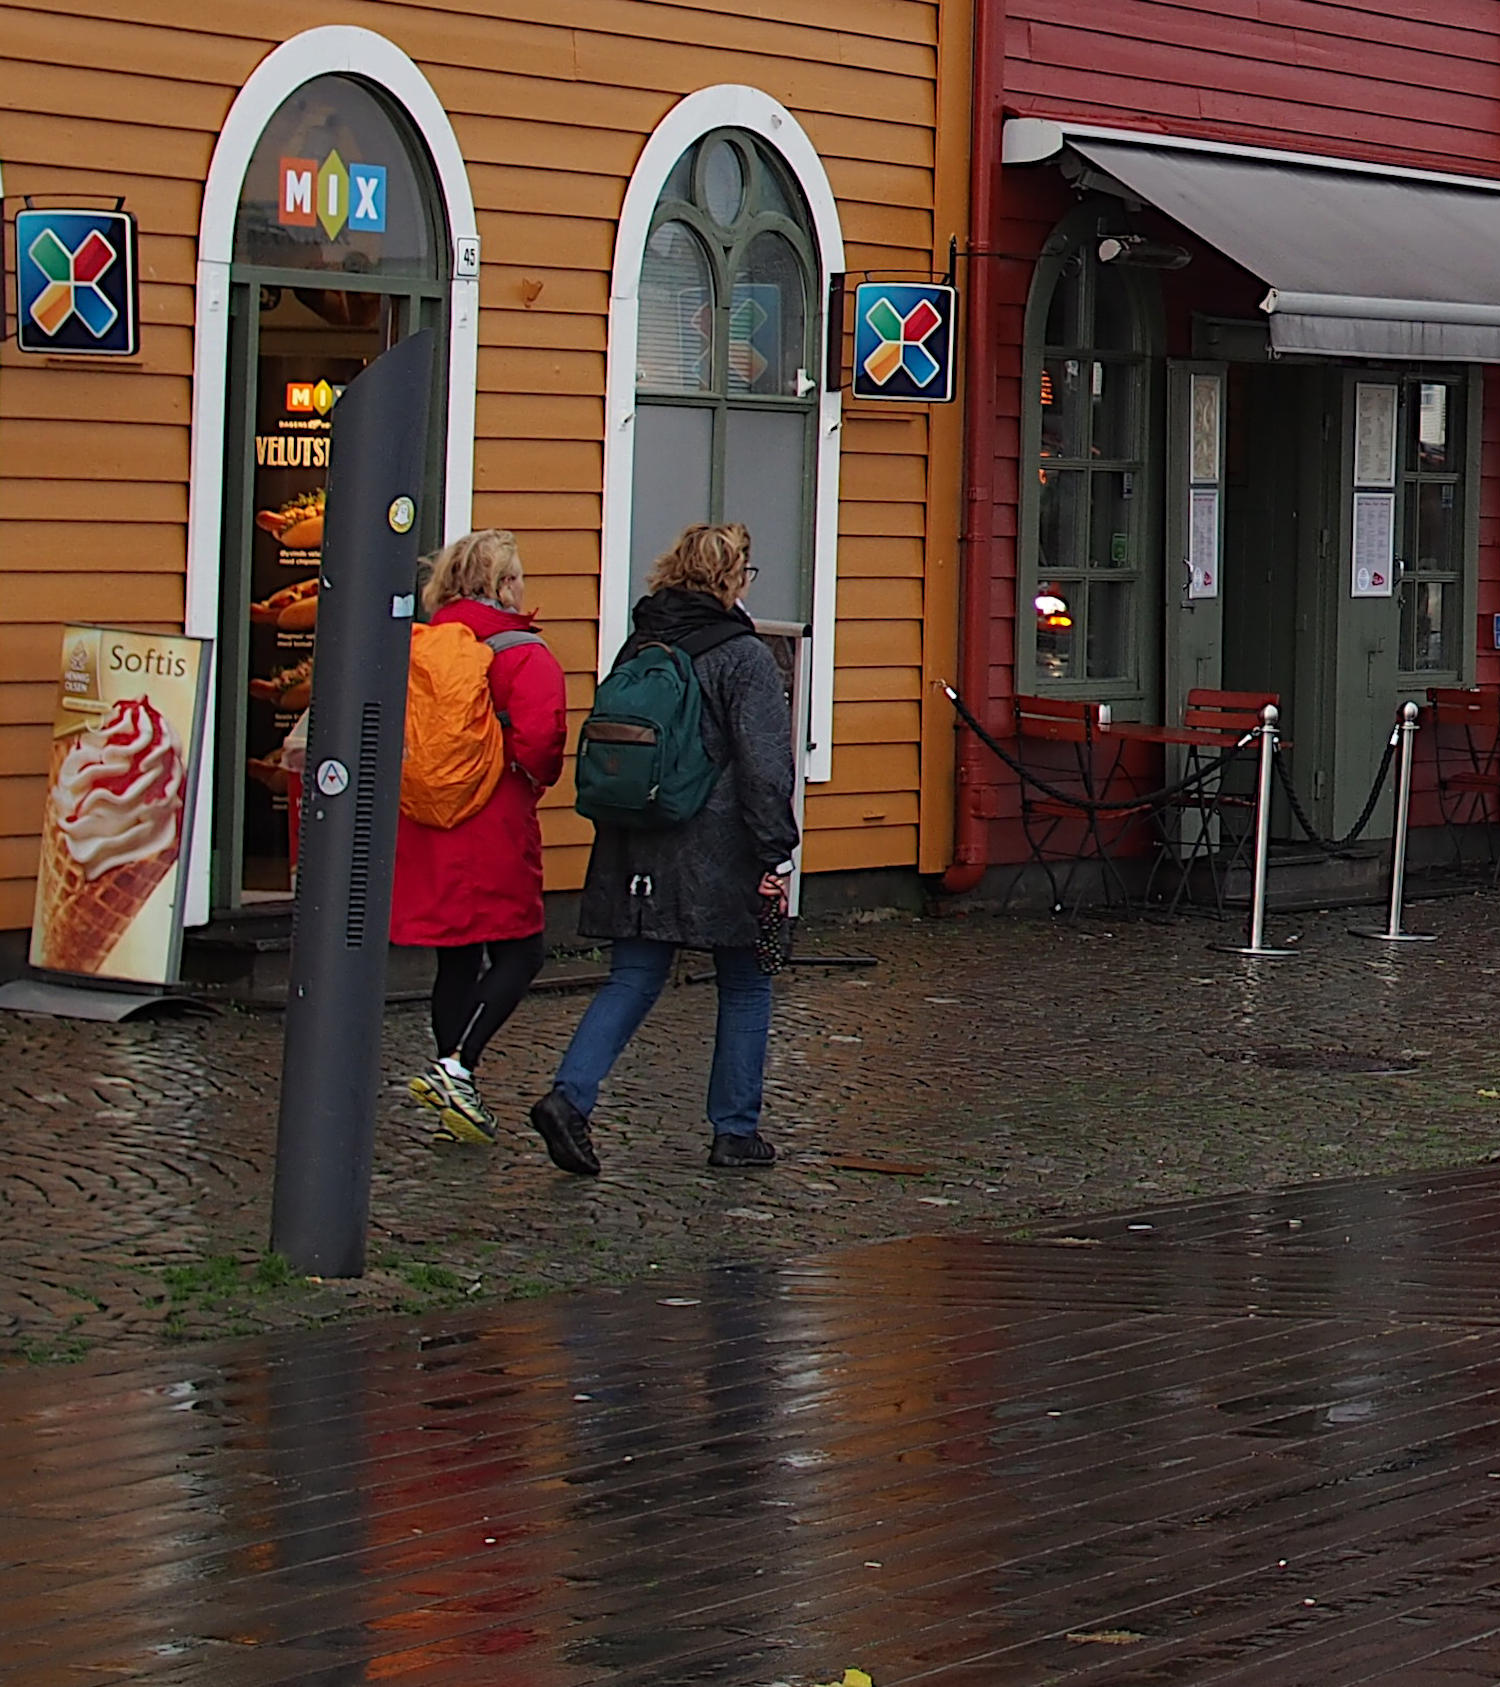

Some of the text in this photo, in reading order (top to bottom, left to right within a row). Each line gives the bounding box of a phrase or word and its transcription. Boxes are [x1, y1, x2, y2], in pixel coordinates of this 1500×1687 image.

[286, 170, 379, 221] MIX
[464, 248, 476, 267] 45
[291, 387, 342, 408] MI
[109, 645, 186, 677] Softis
